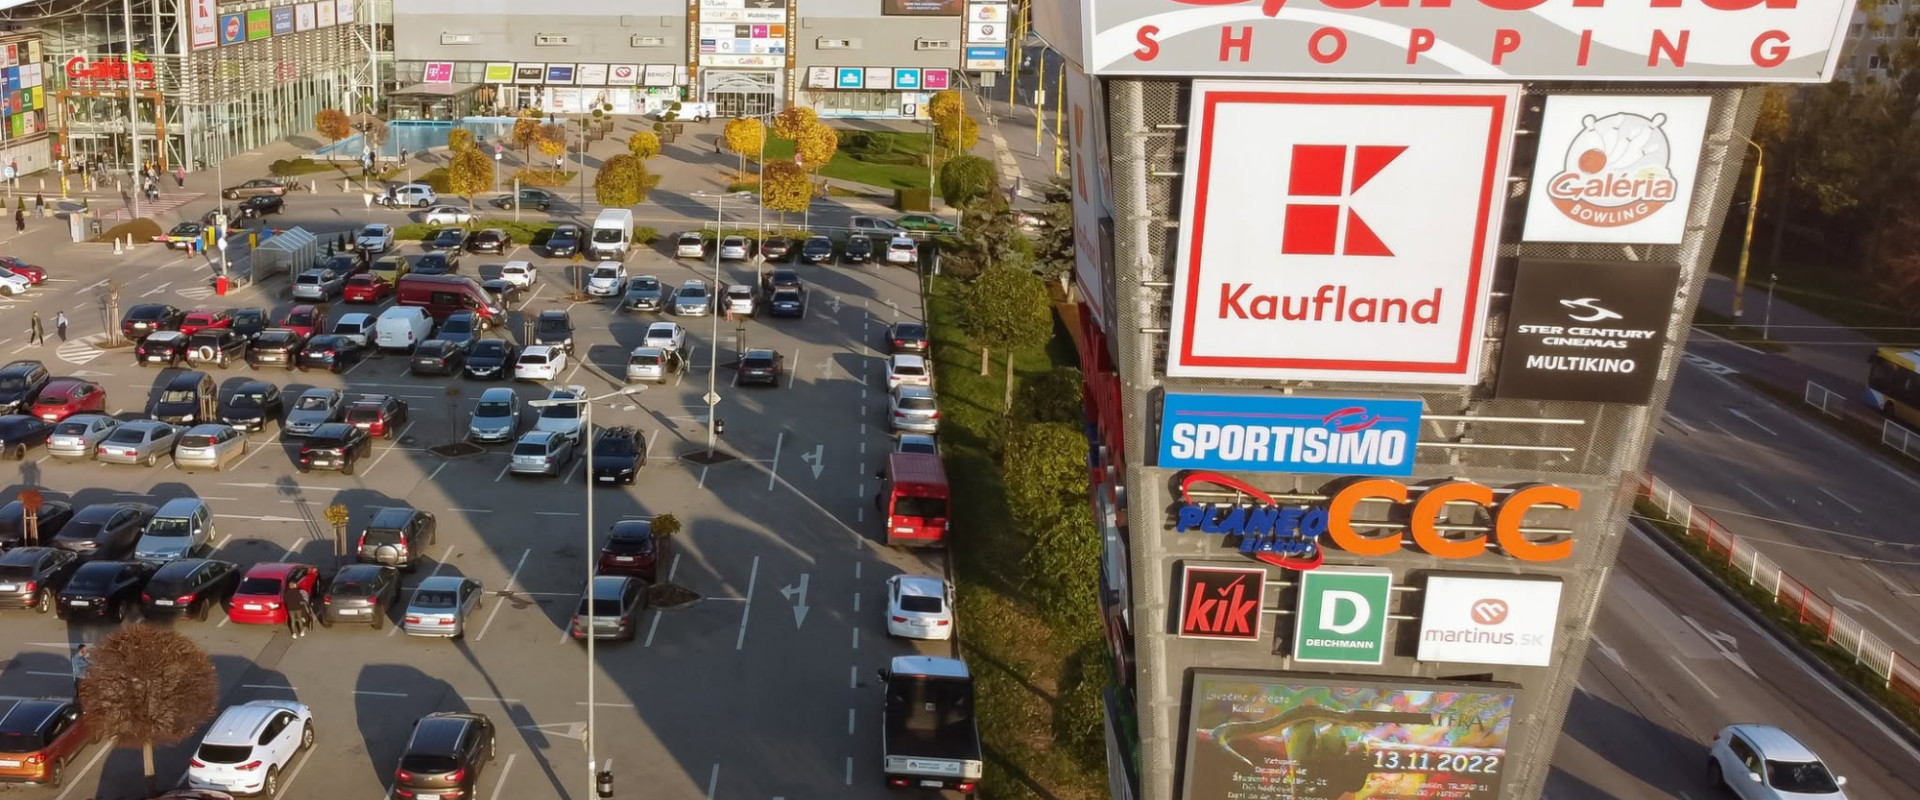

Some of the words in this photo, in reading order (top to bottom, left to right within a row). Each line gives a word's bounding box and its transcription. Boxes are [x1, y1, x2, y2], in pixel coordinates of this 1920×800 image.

[1133, 25, 1792, 68] SHOPPING
[1551, 173, 1676, 199] Galéria
[1570, 203, 1649, 223] BOWLING
[1218, 283, 1443, 324] Kaufland
[1518, 325, 1564, 334] STER
[1568, 326, 1656, 339] CENTURY
[1542, 337, 1628, 349] CINEMAS
[1526, 355, 1635, 374] MULTIKINO
[1171, 422, 1407, 466] SPORTISIMO
[1176, 506, 1328, 536] PLANEO
[1328, 478, 1581, 561] CCC
[1305, 638, 1374, 649] DEICHMANN
[1373, 751, 1499, 774] 13.11.2022
